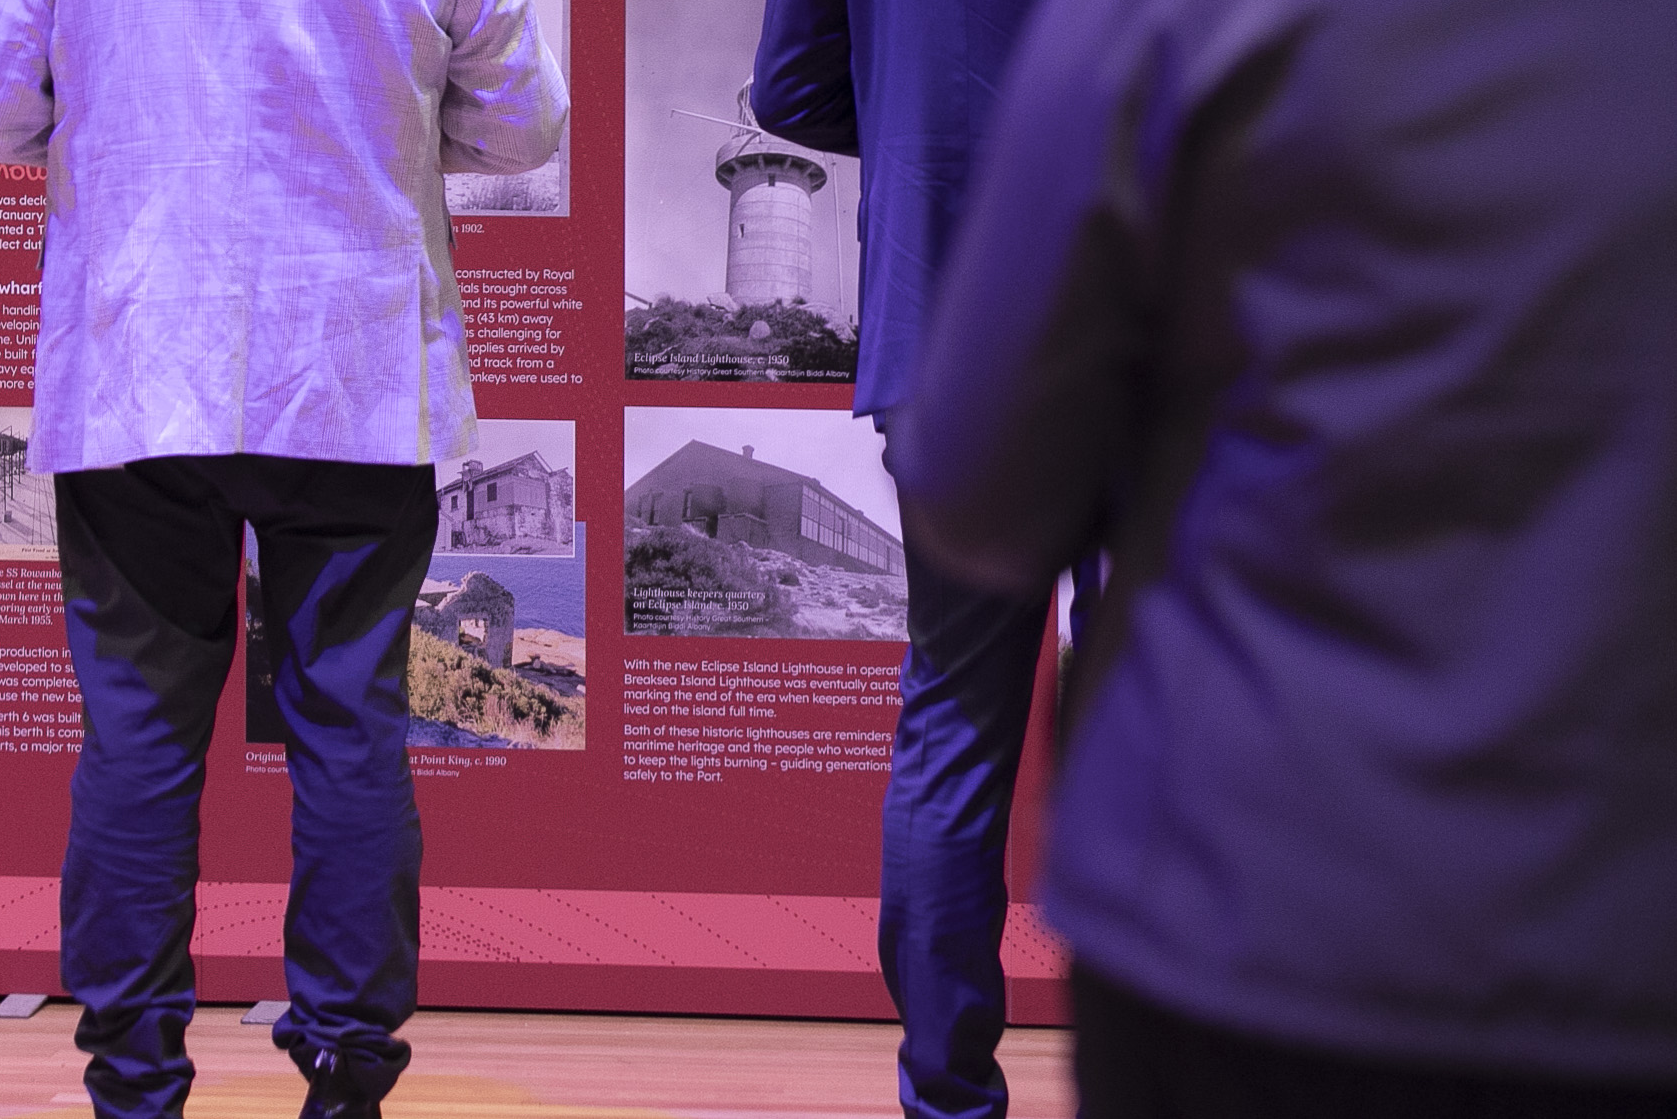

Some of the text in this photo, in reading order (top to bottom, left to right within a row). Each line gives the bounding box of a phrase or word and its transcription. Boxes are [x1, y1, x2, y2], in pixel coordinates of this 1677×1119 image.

[454, 267, 574, 284] constructed by Royal
[30, 614, 52, 626] 1955.
[623, 659, 901, 679] With the new Eclipse Island Lighthouse in operati
